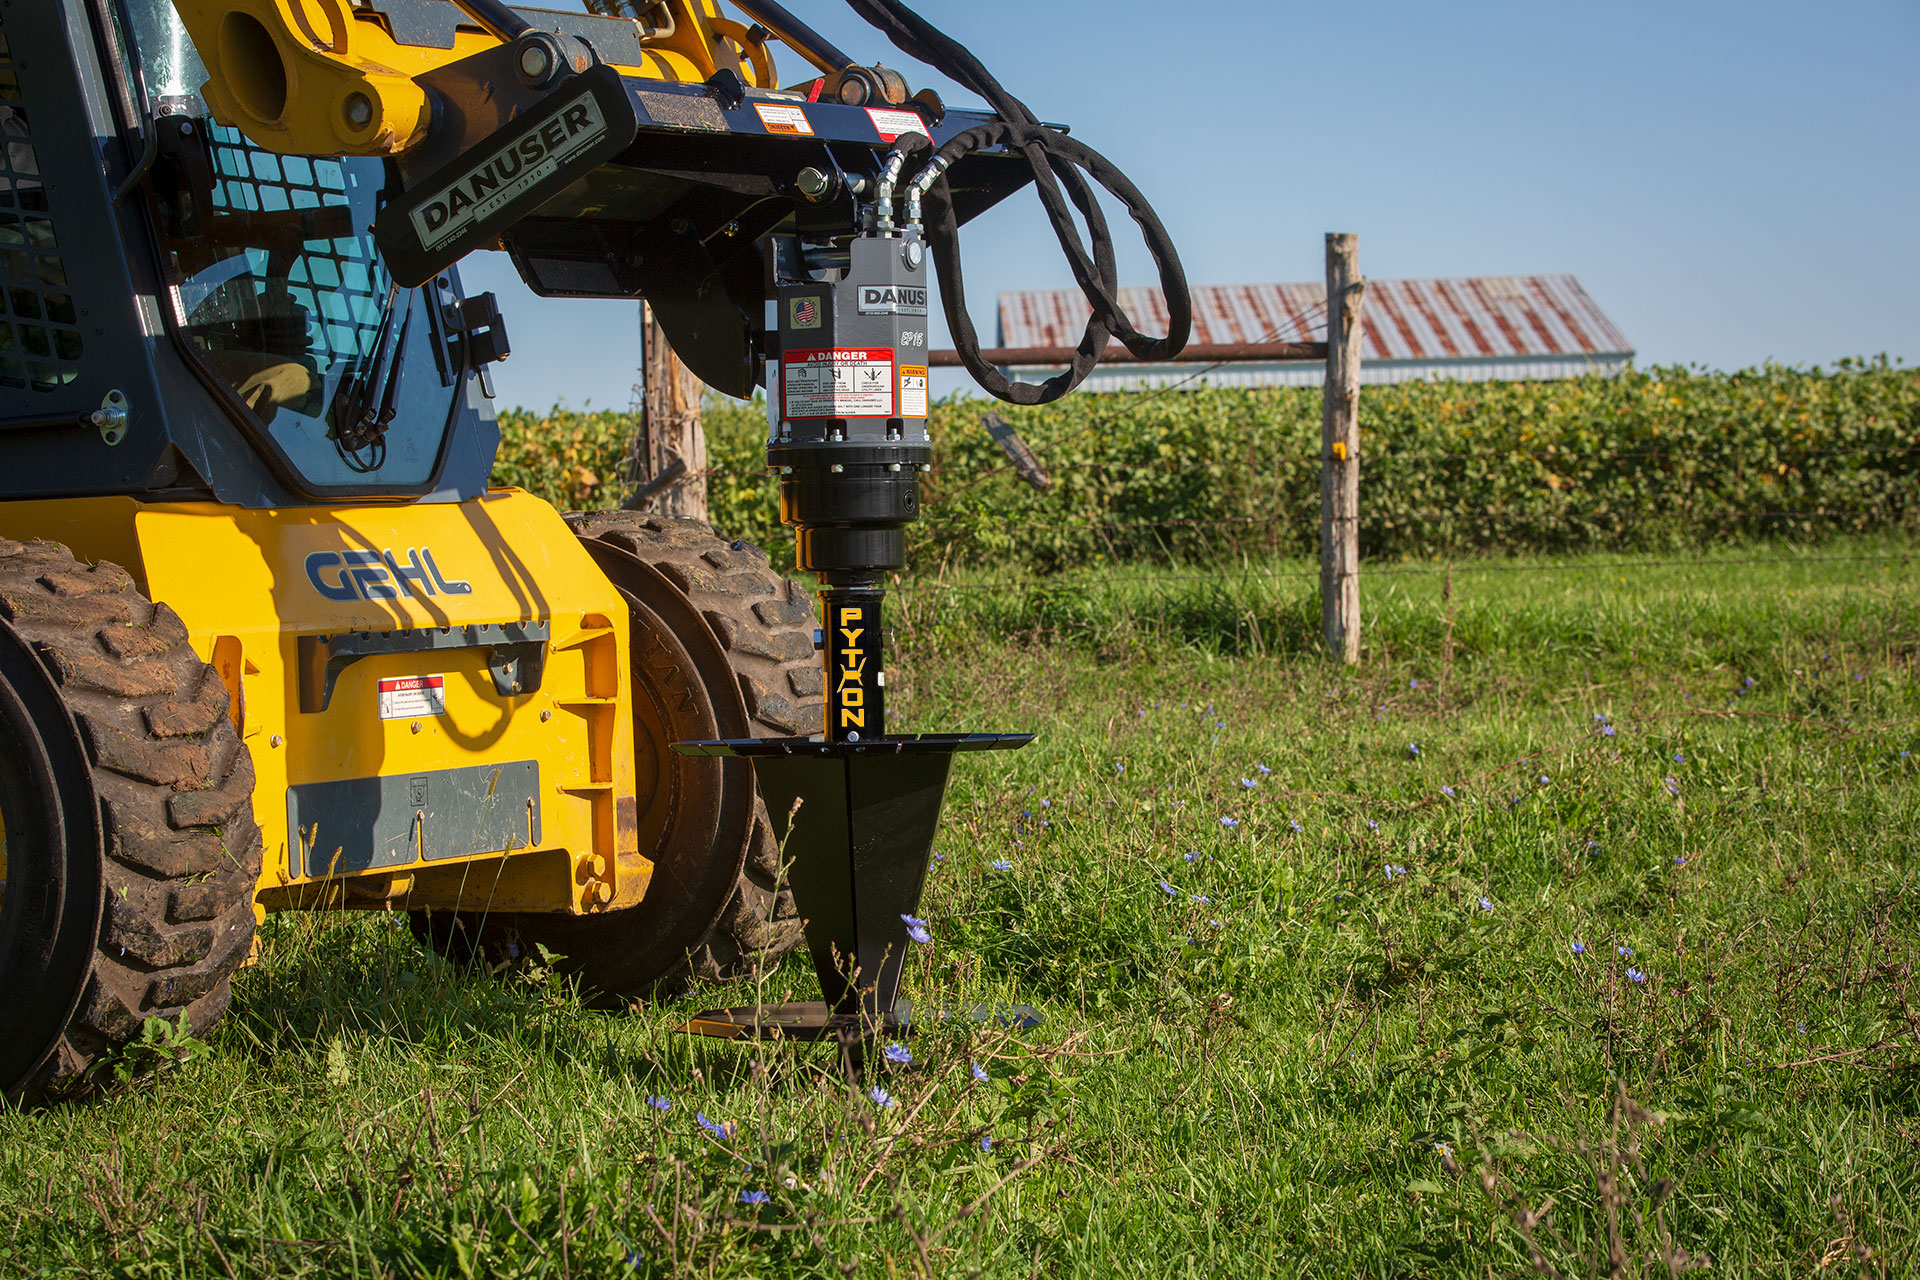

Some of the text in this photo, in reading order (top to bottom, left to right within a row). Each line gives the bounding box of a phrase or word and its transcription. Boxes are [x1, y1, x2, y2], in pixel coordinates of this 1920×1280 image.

[420, 104, 595, 234] DANUSER
[489, 169, 543, 209] EST. 1910
[865, 289, 927, 305] DANUS
[818, 351, 867, 361] DANGER
[304, 547, 472, 601] GEHL
[401, 681, 424, 689] DANGER
[630, 611, 699, 715] ITAN
[837, 608, 867, 727] PYTHON
